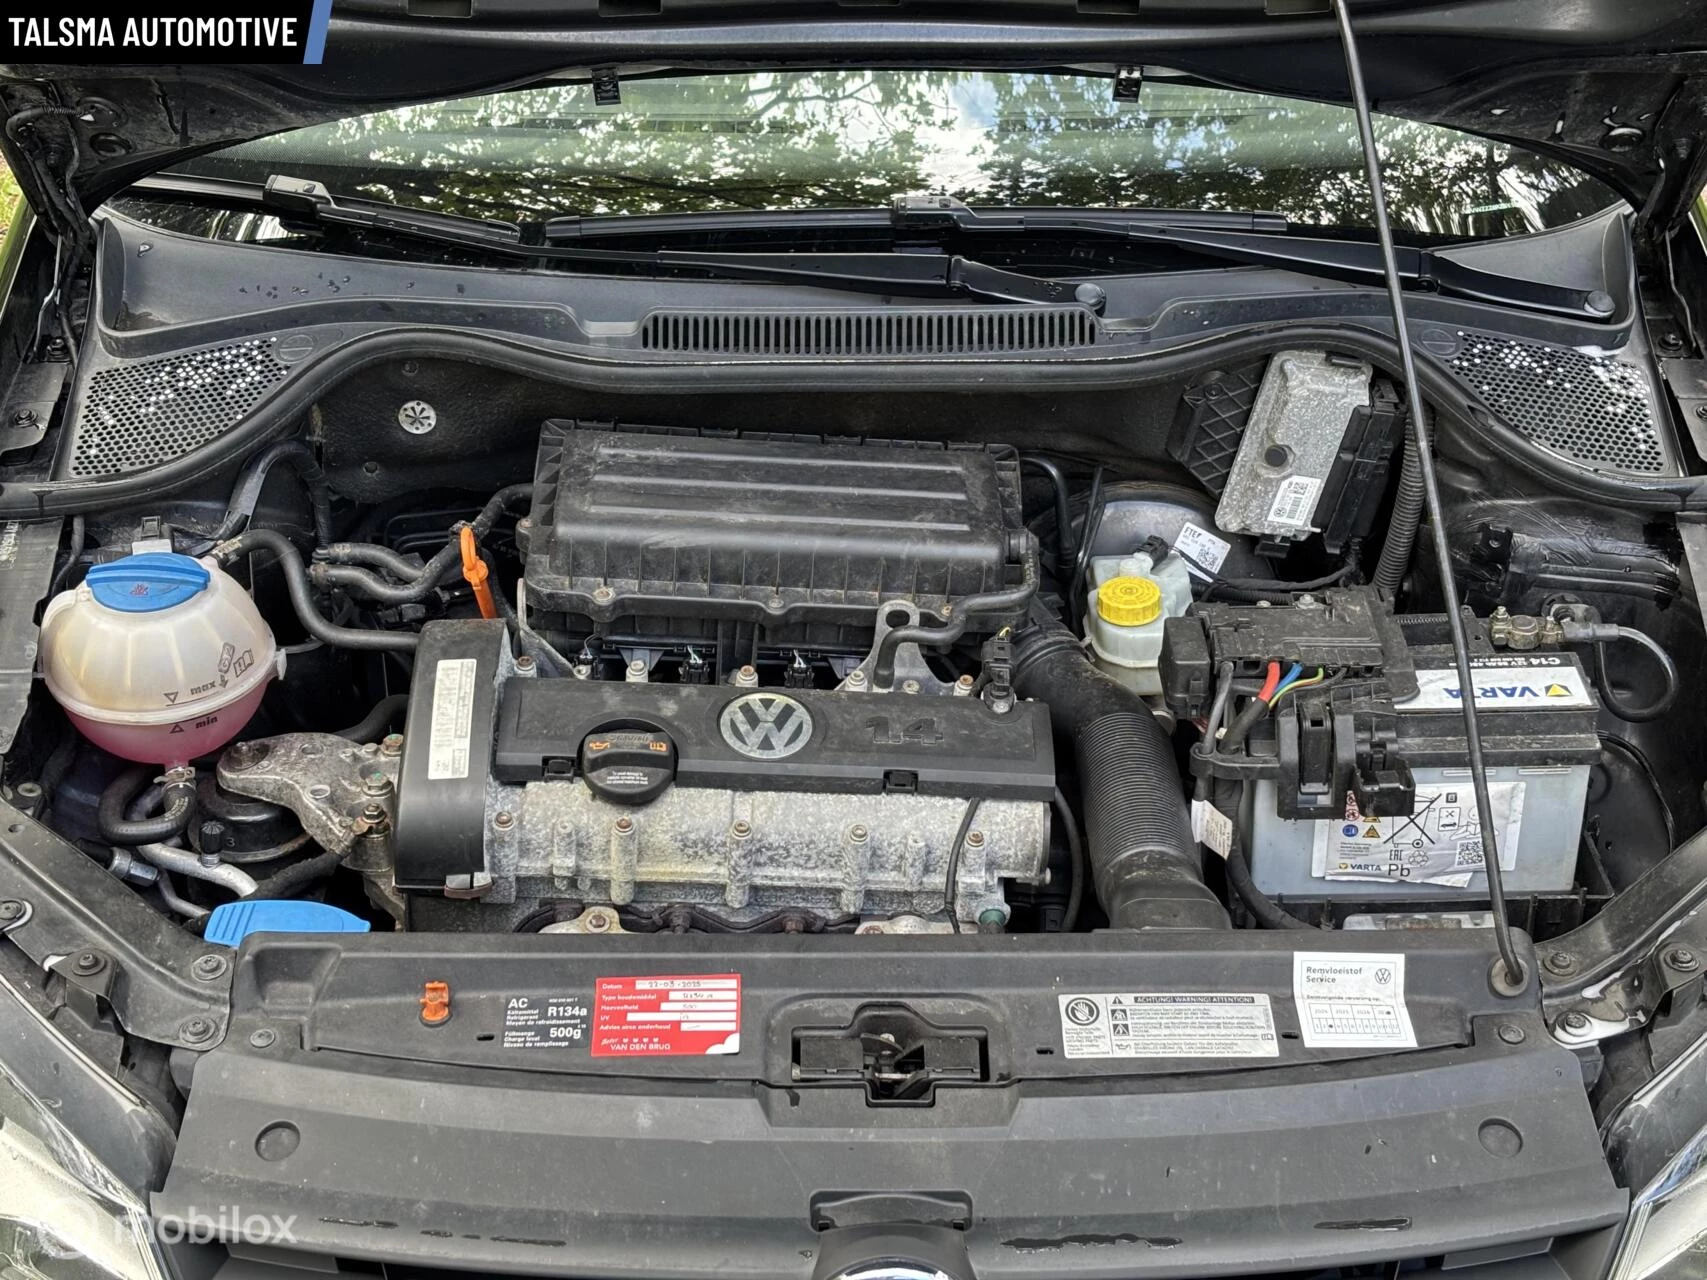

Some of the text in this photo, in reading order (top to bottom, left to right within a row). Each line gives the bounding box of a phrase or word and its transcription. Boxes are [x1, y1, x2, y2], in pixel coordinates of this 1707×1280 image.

[1529, 657, 1561, 665] C14
[190, 680, 217, 695] max
[1443, 686, 1540, 699] VARA
[195, 716, 218, 729] min
[1350, 863, 1382, 872] VARTA
[1387, 863, 1411, 877] Pb
[1306, 966, 1363, 975] Remvloeistof
[1306, 976, 1337, 984] Service
[508, 998, 528, 1008] AC
[547, 1006, 588, 1017] R134a
[599, 1023, 620, 1031] Advies
[549, 1027, 582, 1039] 500g
[610, 1043, 627, 1051] VAN
[629, 1043, 648, 1051] DEN
